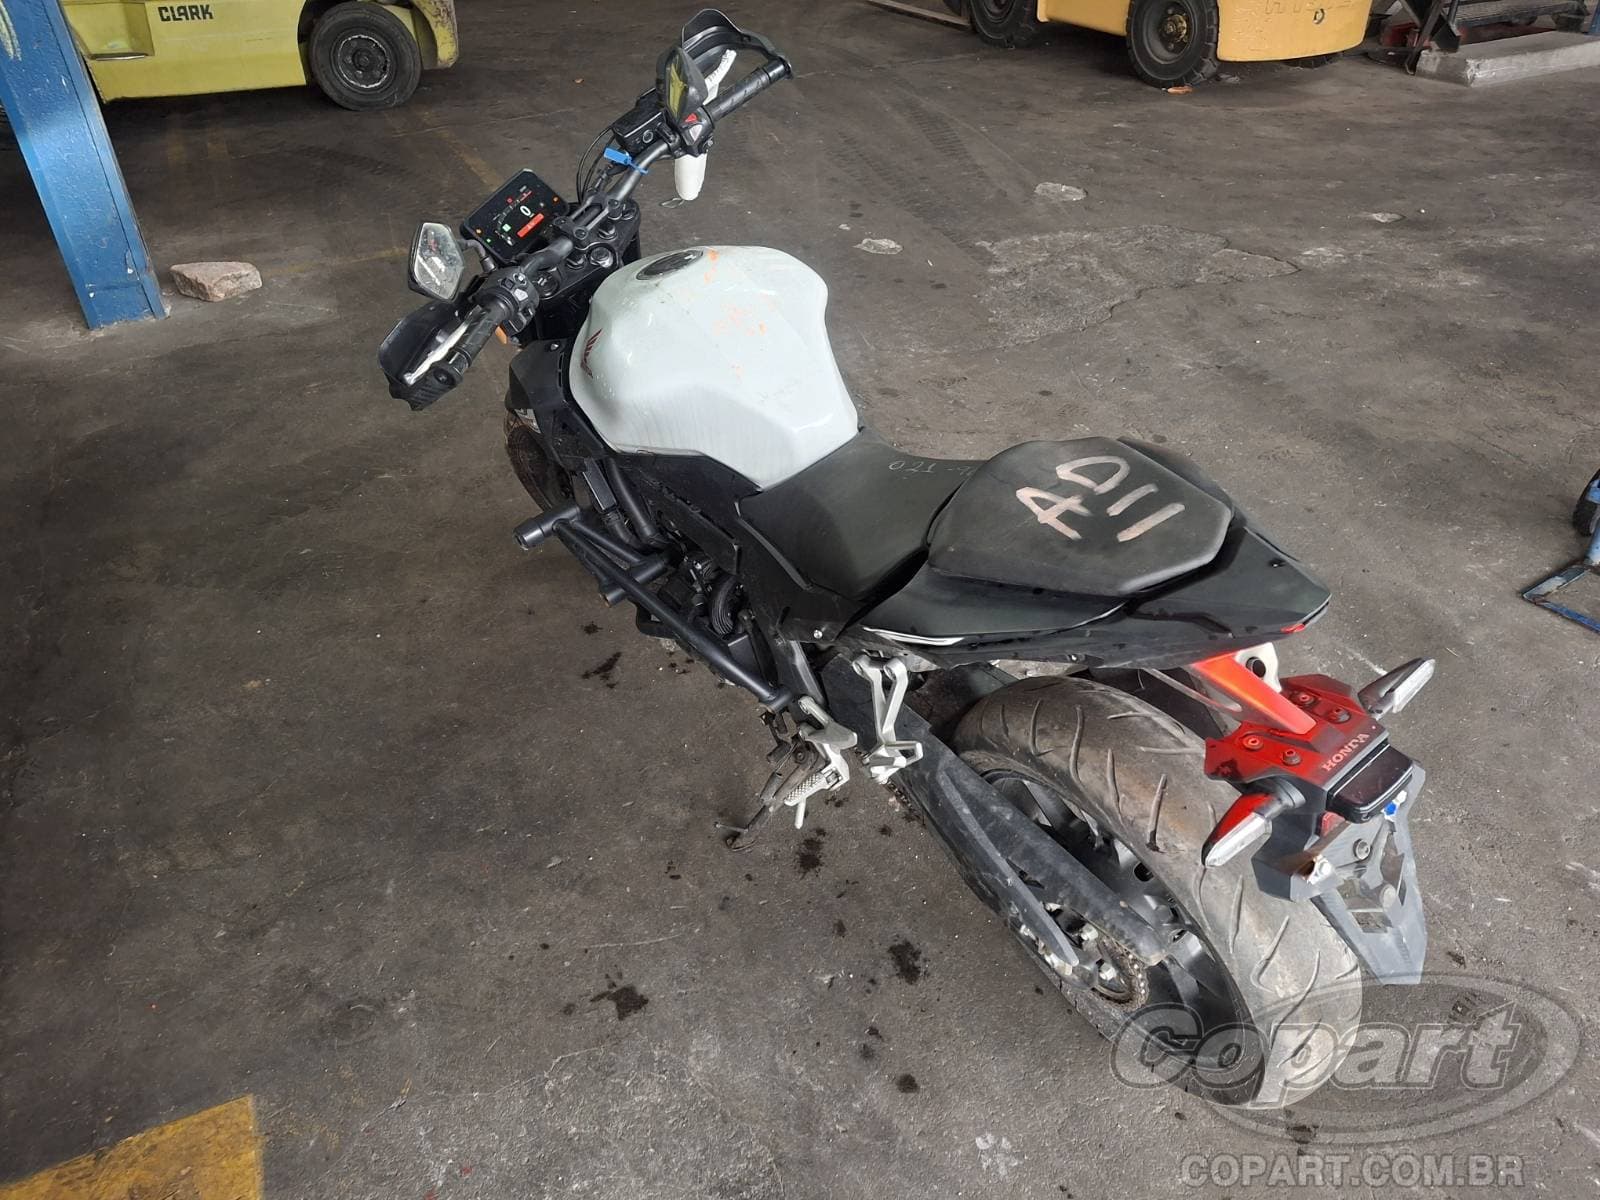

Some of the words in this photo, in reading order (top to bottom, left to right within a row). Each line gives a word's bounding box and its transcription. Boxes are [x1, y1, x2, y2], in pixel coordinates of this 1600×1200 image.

[157, 4, 214, 22] CLARK
[520, 205, 531, 216] 0
[1321, 733, 1370, 772] HONDA
